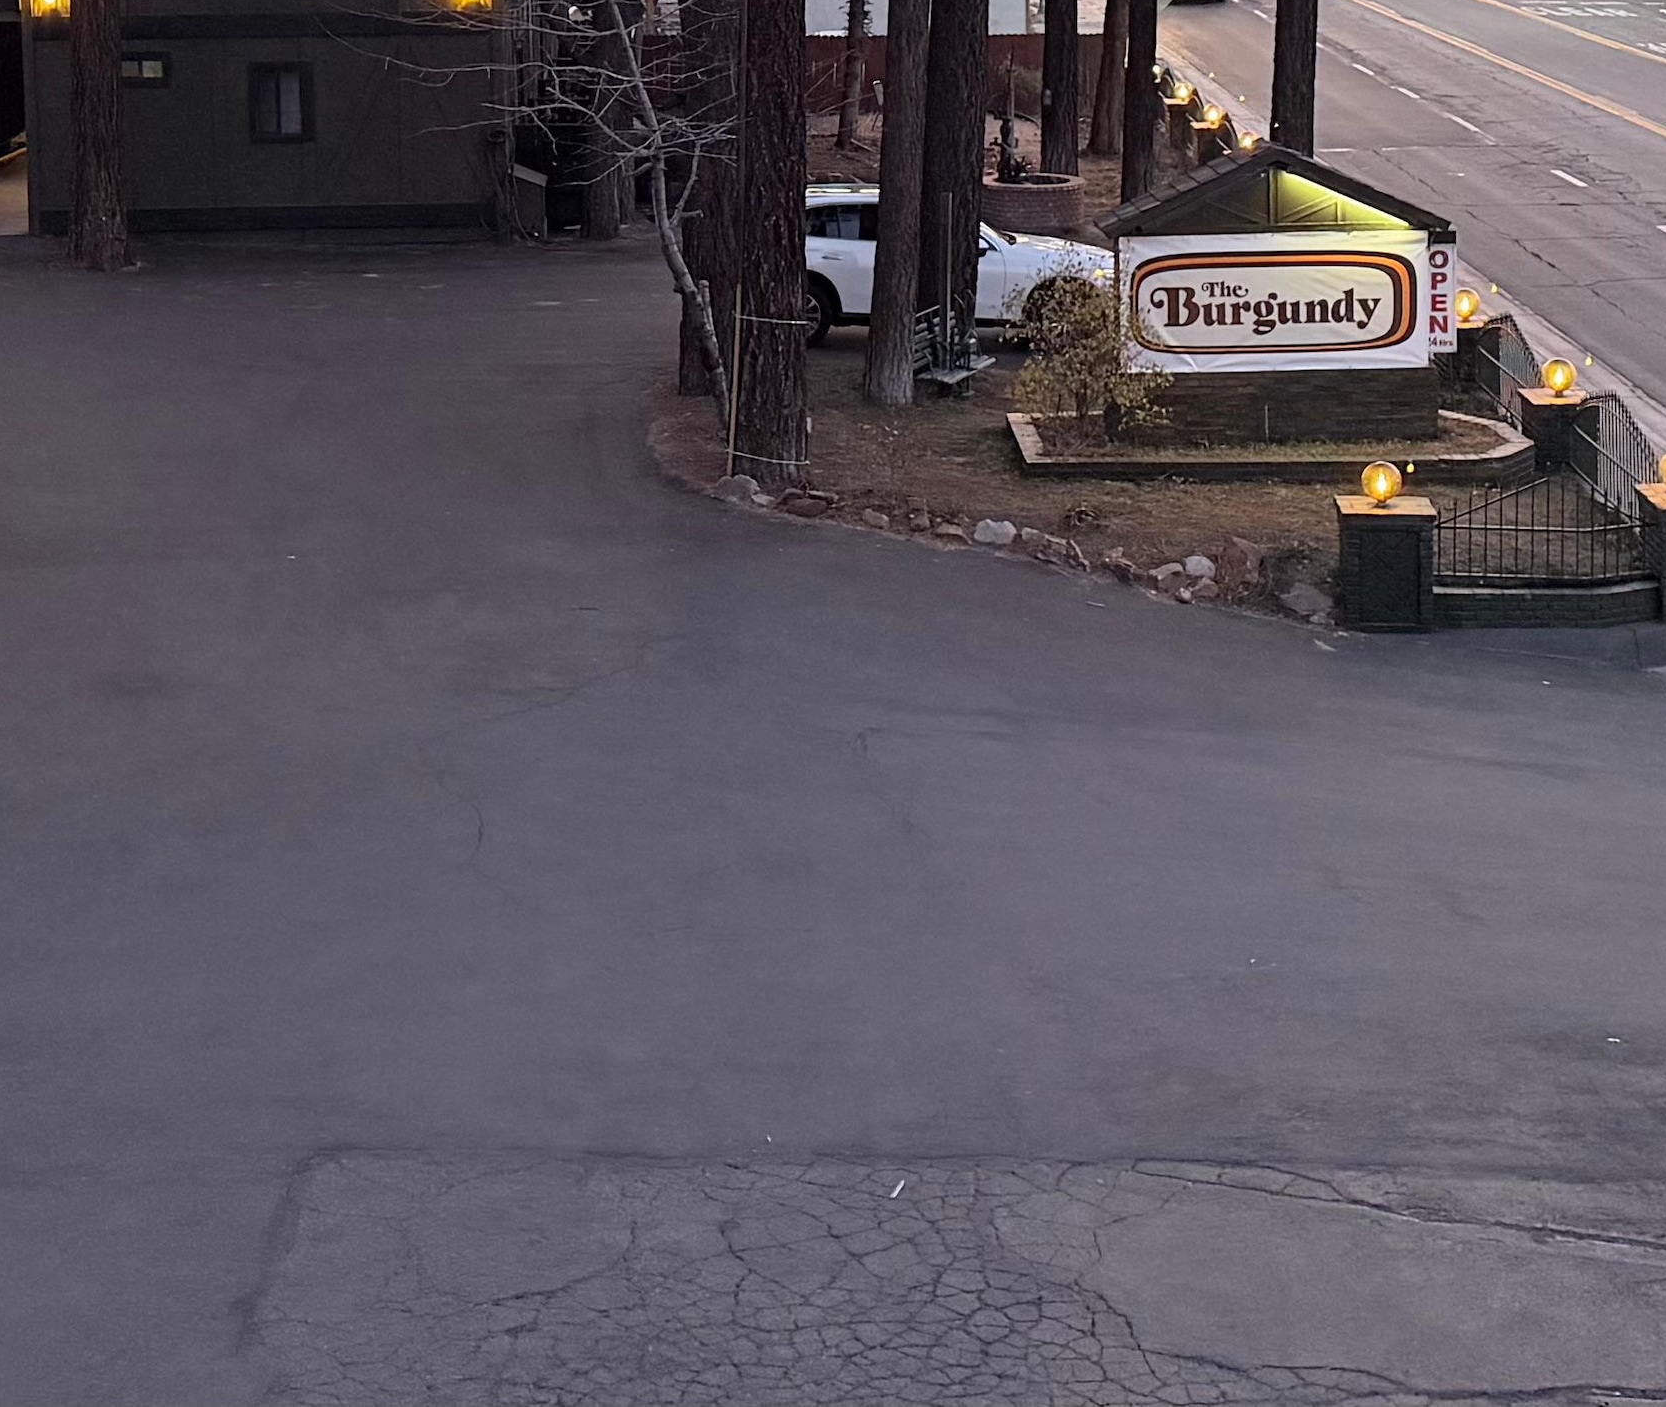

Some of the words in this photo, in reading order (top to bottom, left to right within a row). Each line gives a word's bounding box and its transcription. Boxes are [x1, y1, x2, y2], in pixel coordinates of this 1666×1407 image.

[1150, 287, 1383, 336] Burgundy
[1201, 280, 1249, 299] The
[1429, 250, 1449, 334] OPEN
